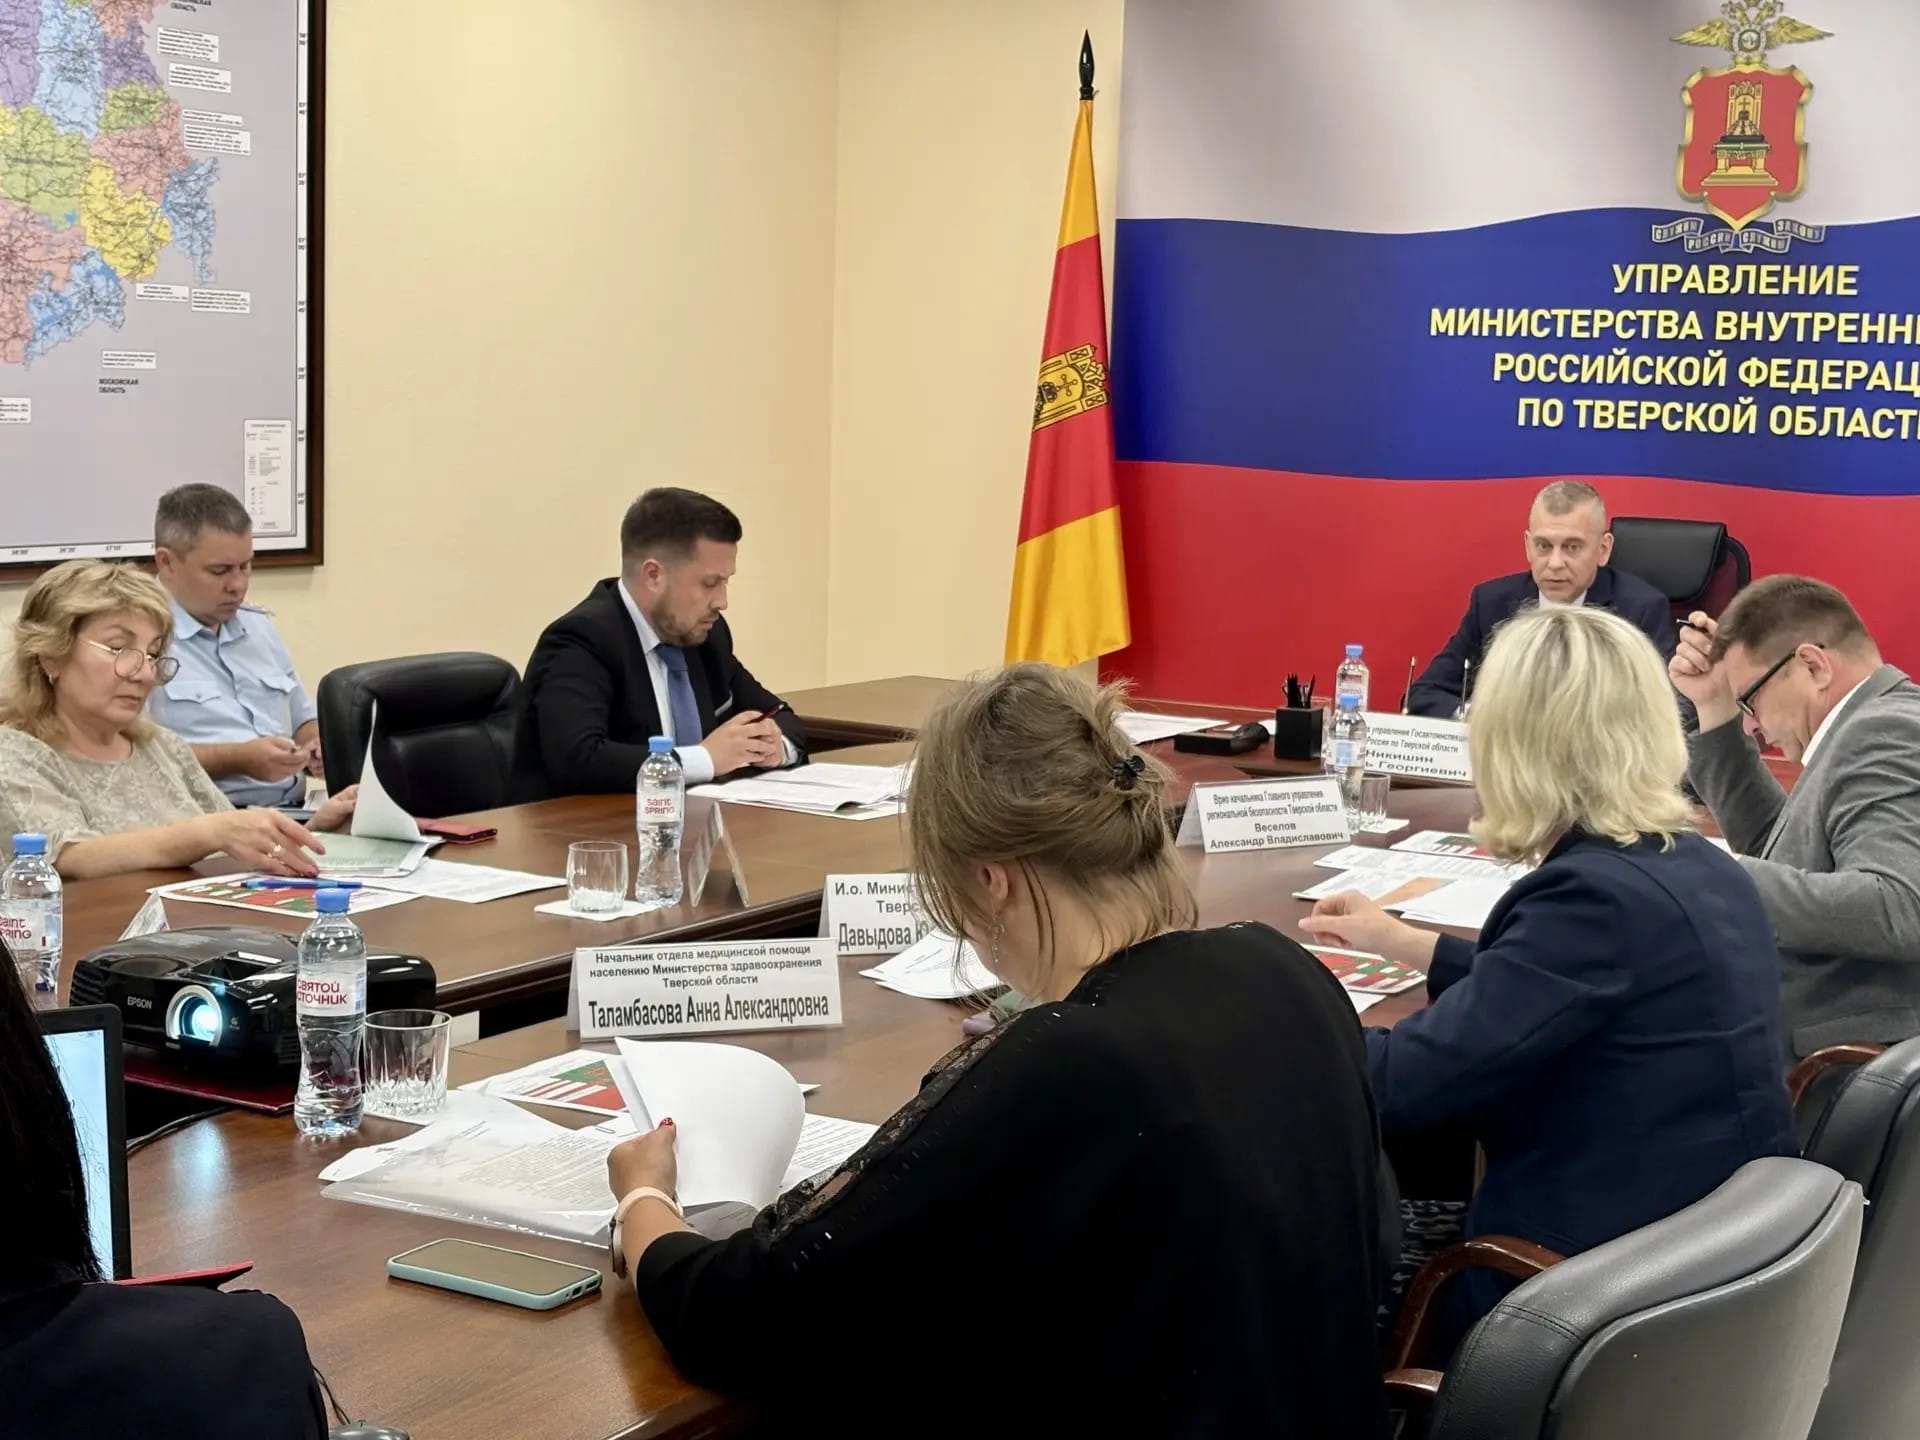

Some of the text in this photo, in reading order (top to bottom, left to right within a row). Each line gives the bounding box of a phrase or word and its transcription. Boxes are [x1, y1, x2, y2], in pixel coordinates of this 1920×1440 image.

[1654, 218, 1699, 241] СЛУЖИМ
[1688, 230, 1732, 250] РОССИИ
[1742, 231, 1786, 250] СЛУЖИМ
[1612, 264, 1859, 295] УПРАВЛЕНИЕ
[1430, 308, 1920, 344] МИНИСТЕРСТВА ВНУТРЕНН
[1493, 348, 1726, 387] РОССИЙСКОЙ
[1518, 397, 1920, 440] ПО ТВЕРСКОЙ ОБЛАСТ
[1400, 739, 1430, 751] Тверской
[1431, 744, 1459, 753] области
[1366, 749, 1433, 763] Никишин
[1379, 761, 1466, 777] Георгиевич
[1230, 793, 1263, 804] начальника
[1264, 790, 1291, 802] Главного
[1291, 789, 1324, 802] управления
[1206, 802, 1338, 821] региональной безопасности Тверской области
[1254, 822, 1297, 833] Веселов
[1210, 832, 1344, 850] Александр Владиславович
[835, 882, 912, 895] И.о. Мини
[876, 900, 921, 915] Тверс
[838, 923, 911, 951] Давыдова
[595, 945, 811, 964] Начальник отдела медицинской помощи
[590, 958, 822, 977] населению Министерства здравоохранения
[662, 975, 758, 989] Тверской области
[127, 996, 153, 1009] EPSON
[588, 992, 829, 1028] Таламбасова Анна Александровна
